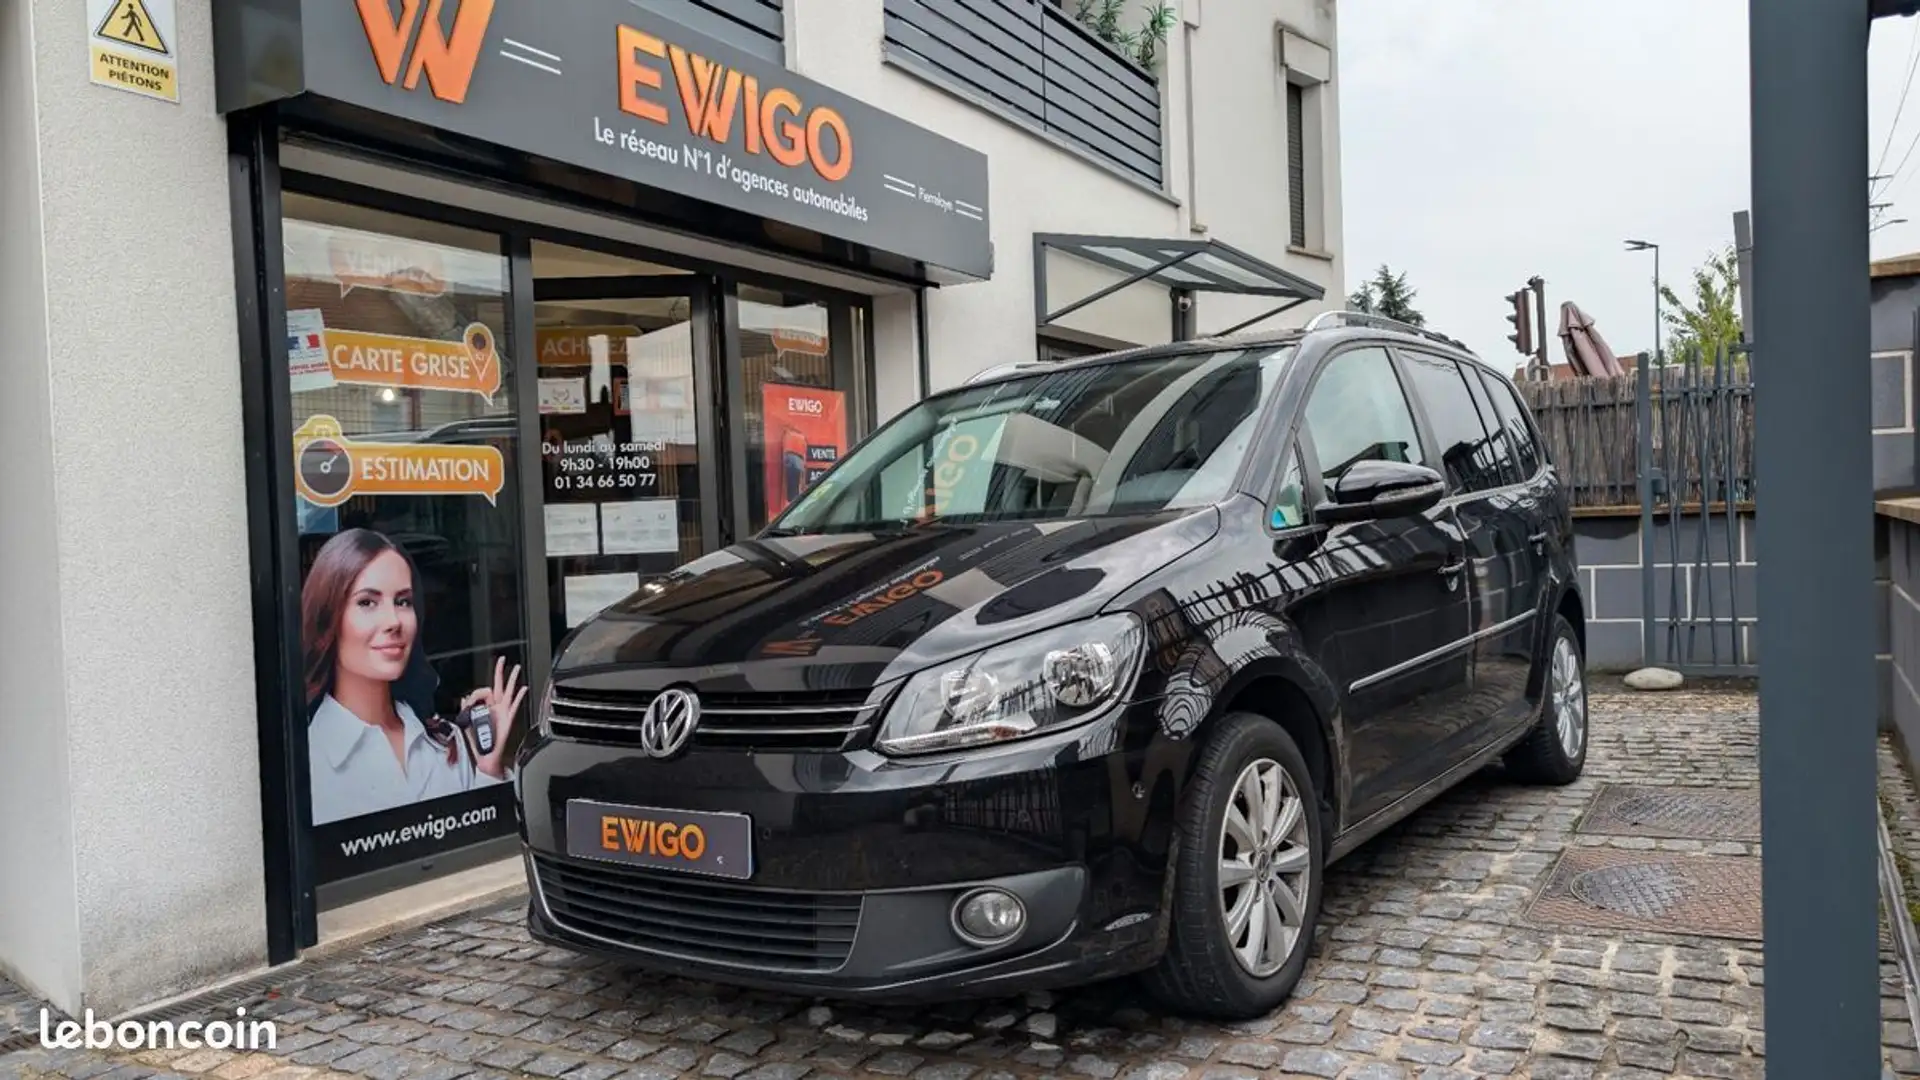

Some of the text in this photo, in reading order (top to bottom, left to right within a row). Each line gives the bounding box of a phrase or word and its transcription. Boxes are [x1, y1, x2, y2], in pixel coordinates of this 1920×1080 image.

[99, 53, 170, 80] ATTENTION
[108, 69, 163, 91] PIÉTONS
[616, 23, 853, 181] EWIGO
[594, 116, 616, 146] Le
[619, 128, 679, 165] réseau
[683, 143, 712, 175] N°1
[792, 186, 869, 223] automobiles
[332, 344, 405, 373] CARTE
[409, 350, 471, 379] GRISE
[788, 397, 823, 414] EWIGO
[541, 439, 667, 455] Du lundi au samedi
[811, 447, 836, 460] VENTE
[361, 456, 490, 482] ESTIMATION
[559, 457, 595, 472] 9h30
[608, 455, 650, 470] 19h00
[554, 473, 657, 490] 01 34 66 50 77
[341, 804, 497, 857] www.ewigo.com
[601, 815, 705, 860] EWIGO
